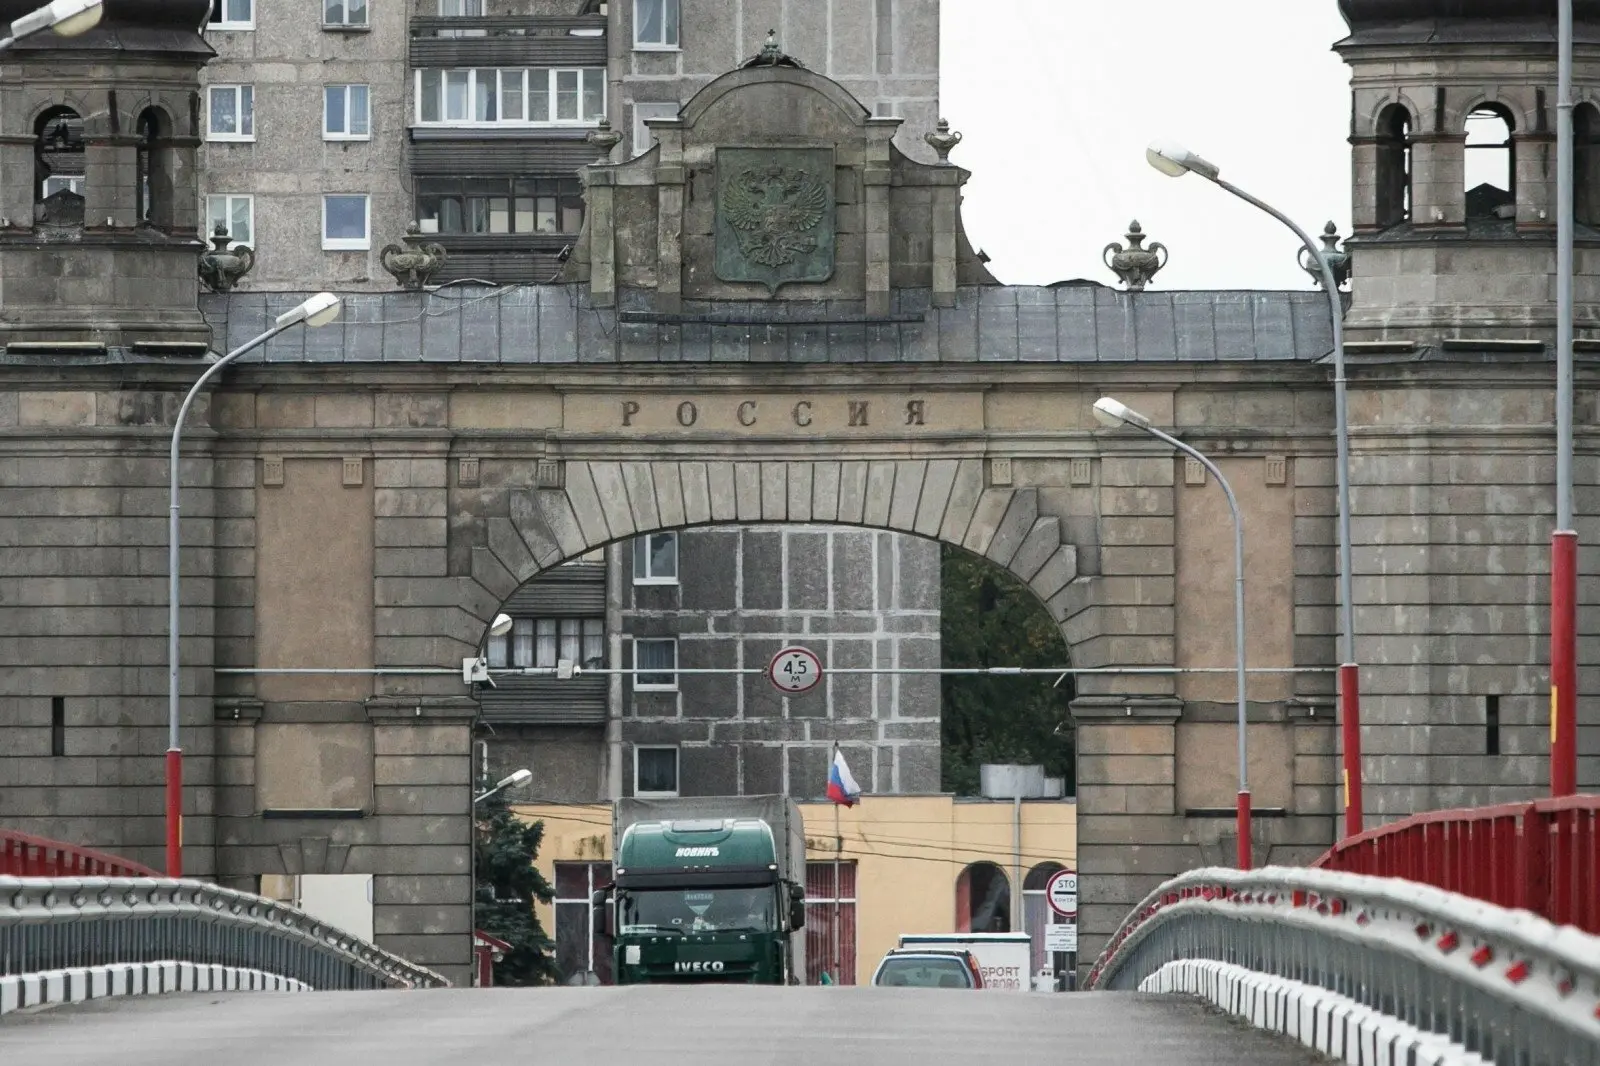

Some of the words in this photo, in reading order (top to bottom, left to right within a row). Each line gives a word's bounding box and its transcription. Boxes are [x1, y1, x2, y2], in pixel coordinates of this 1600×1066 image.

[620, 400, 926, 427] РОССИЯ
[784, 661, 806, 674] 4.5
[674, 961, 724, 972] IVECO
